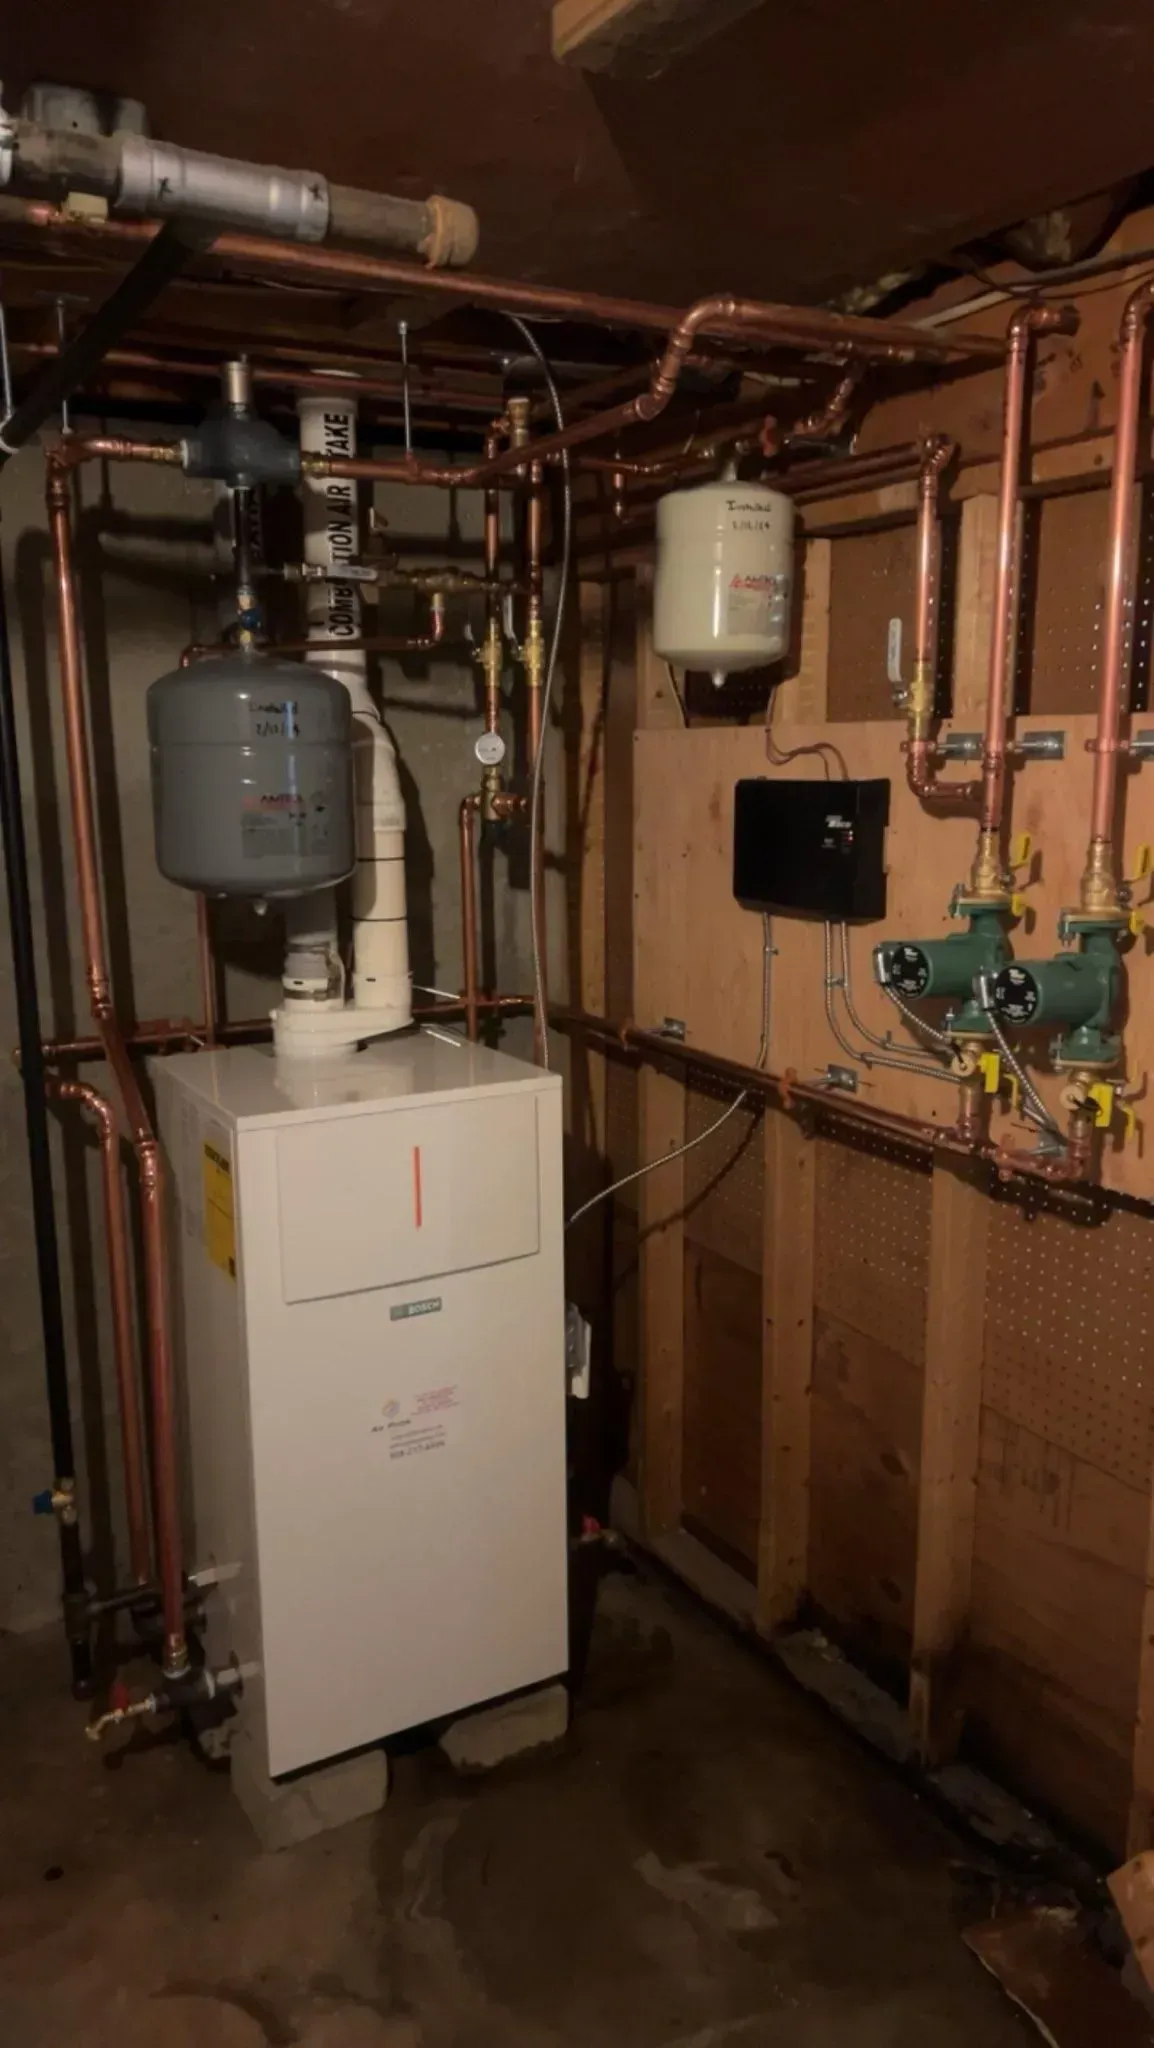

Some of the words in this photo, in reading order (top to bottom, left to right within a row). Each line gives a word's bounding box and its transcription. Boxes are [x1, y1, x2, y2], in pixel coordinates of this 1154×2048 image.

[324, 412, 352, 458] TAKE
[327, 485, 352, 518] AIR
[327, 523, 355, 637] COMBTION
[409, 1301, 440, 1315] BOSCH
